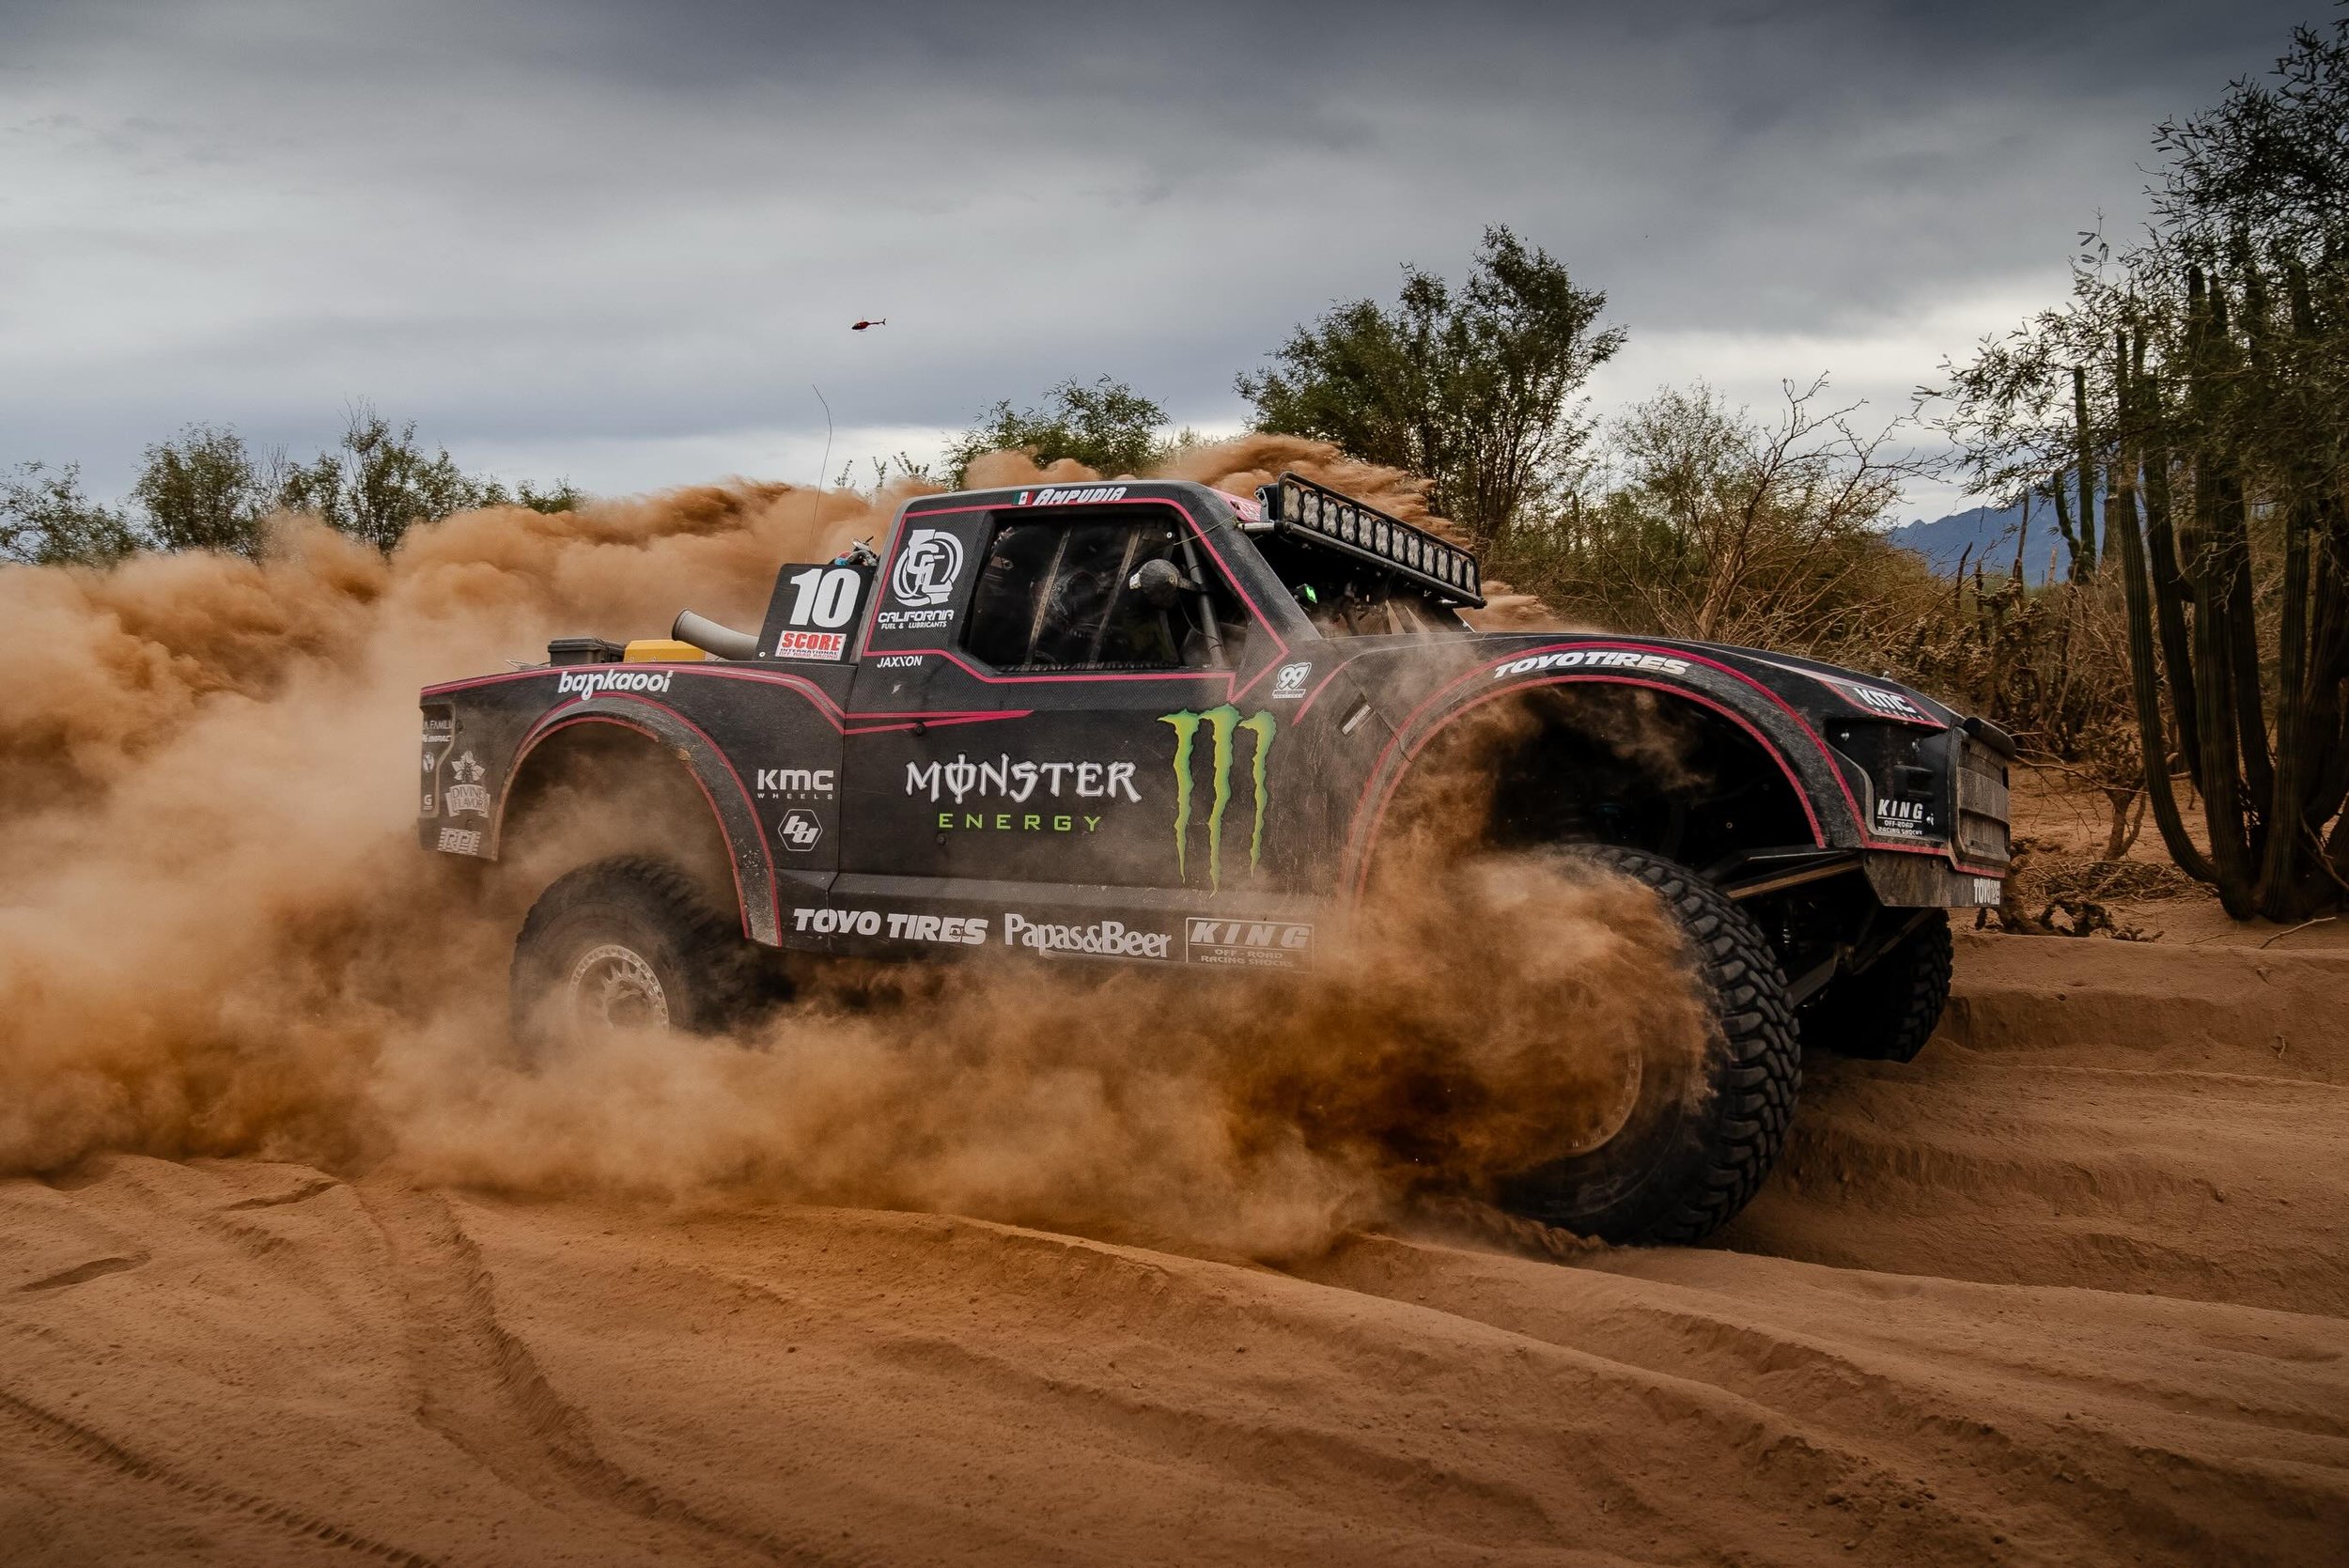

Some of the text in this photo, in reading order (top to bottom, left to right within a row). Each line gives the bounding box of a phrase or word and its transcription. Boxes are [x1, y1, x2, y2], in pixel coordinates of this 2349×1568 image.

[1033, 488, 1127, 505] AMPUDIA
[790, 568, 861, 628] 10
[879, 610, 954, 623] CALIFORNIA
[782, 632, 842, 651] SCORE
[1278, 666, 1310, 690] 99
[757, 769, 834, 790] KMC
[906, 753, 1143, 803] MONSTER
[452, 787, 485, 800] DIVINE
[1877, 799, 1923, 819] KING
[939, 813, 1101, 832] ENERGY
[794, 908, 988, 945] TOYO TIRES
[1004, 913, 1173, 958] Papas&Beer
[1190, 922, 1310, 949] KING
[1201, 955, 1246, 964] RACING
